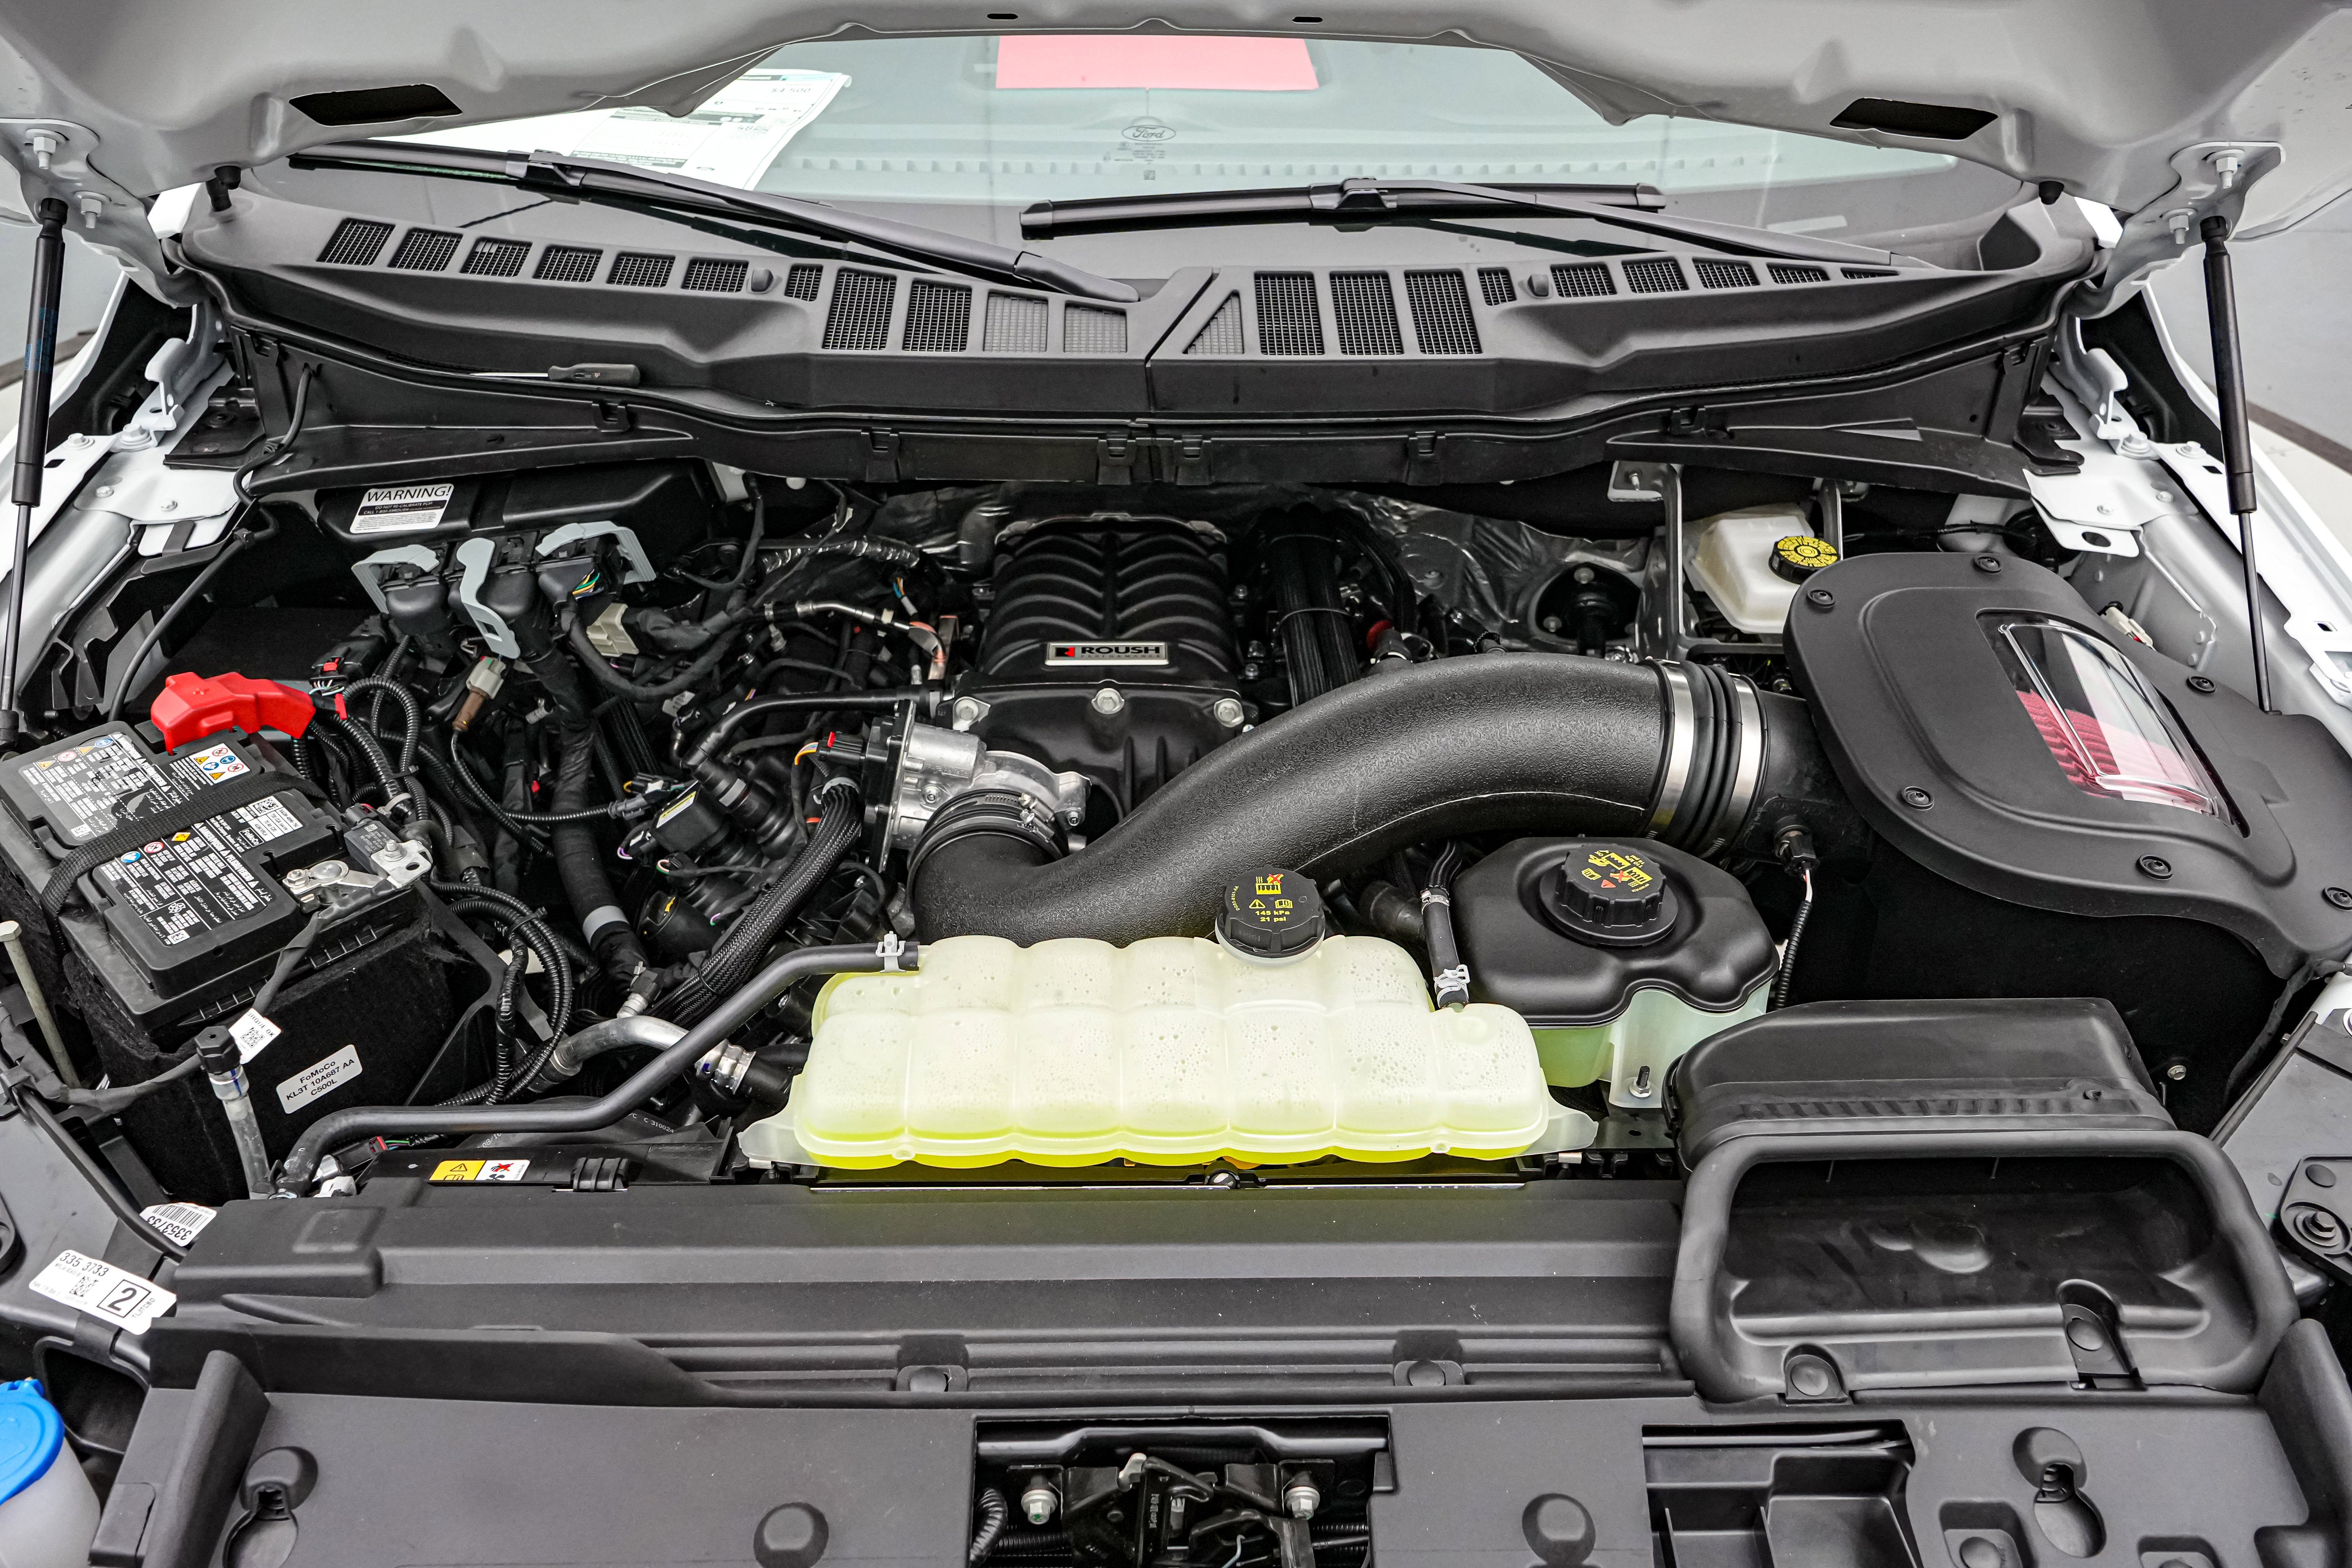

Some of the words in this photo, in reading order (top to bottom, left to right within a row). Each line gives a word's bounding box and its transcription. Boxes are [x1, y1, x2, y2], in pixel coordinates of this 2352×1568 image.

[1132, 126, 1165, 139] Ford
[368, 486, 452, 502] WARNING!
[241, 829, 260, 846] FoMoCo
[197, 826, 226, 851] DANGER/POISON
[224, 854, 255, 882] PELIGRO/VENENO
[247, 1011, 266, 1029] ORQUE
[266, 1027, 275, 1038] OK
[286, 1085, 308, 1101] KL3T
[310, 1067, 341, 1087] 10A687
[342, 1058, 355, 1070] AA
[299, 1060, 336, 1084] FoMoCo
[310, 1079, 338, 1096] C500L
[651, 1120, 674, 1133] 310024
[60, 1252, 82, 1267] 335
[82, 1262, 109, 1277] 3733
[107, 1287, 137, 1311] 2
